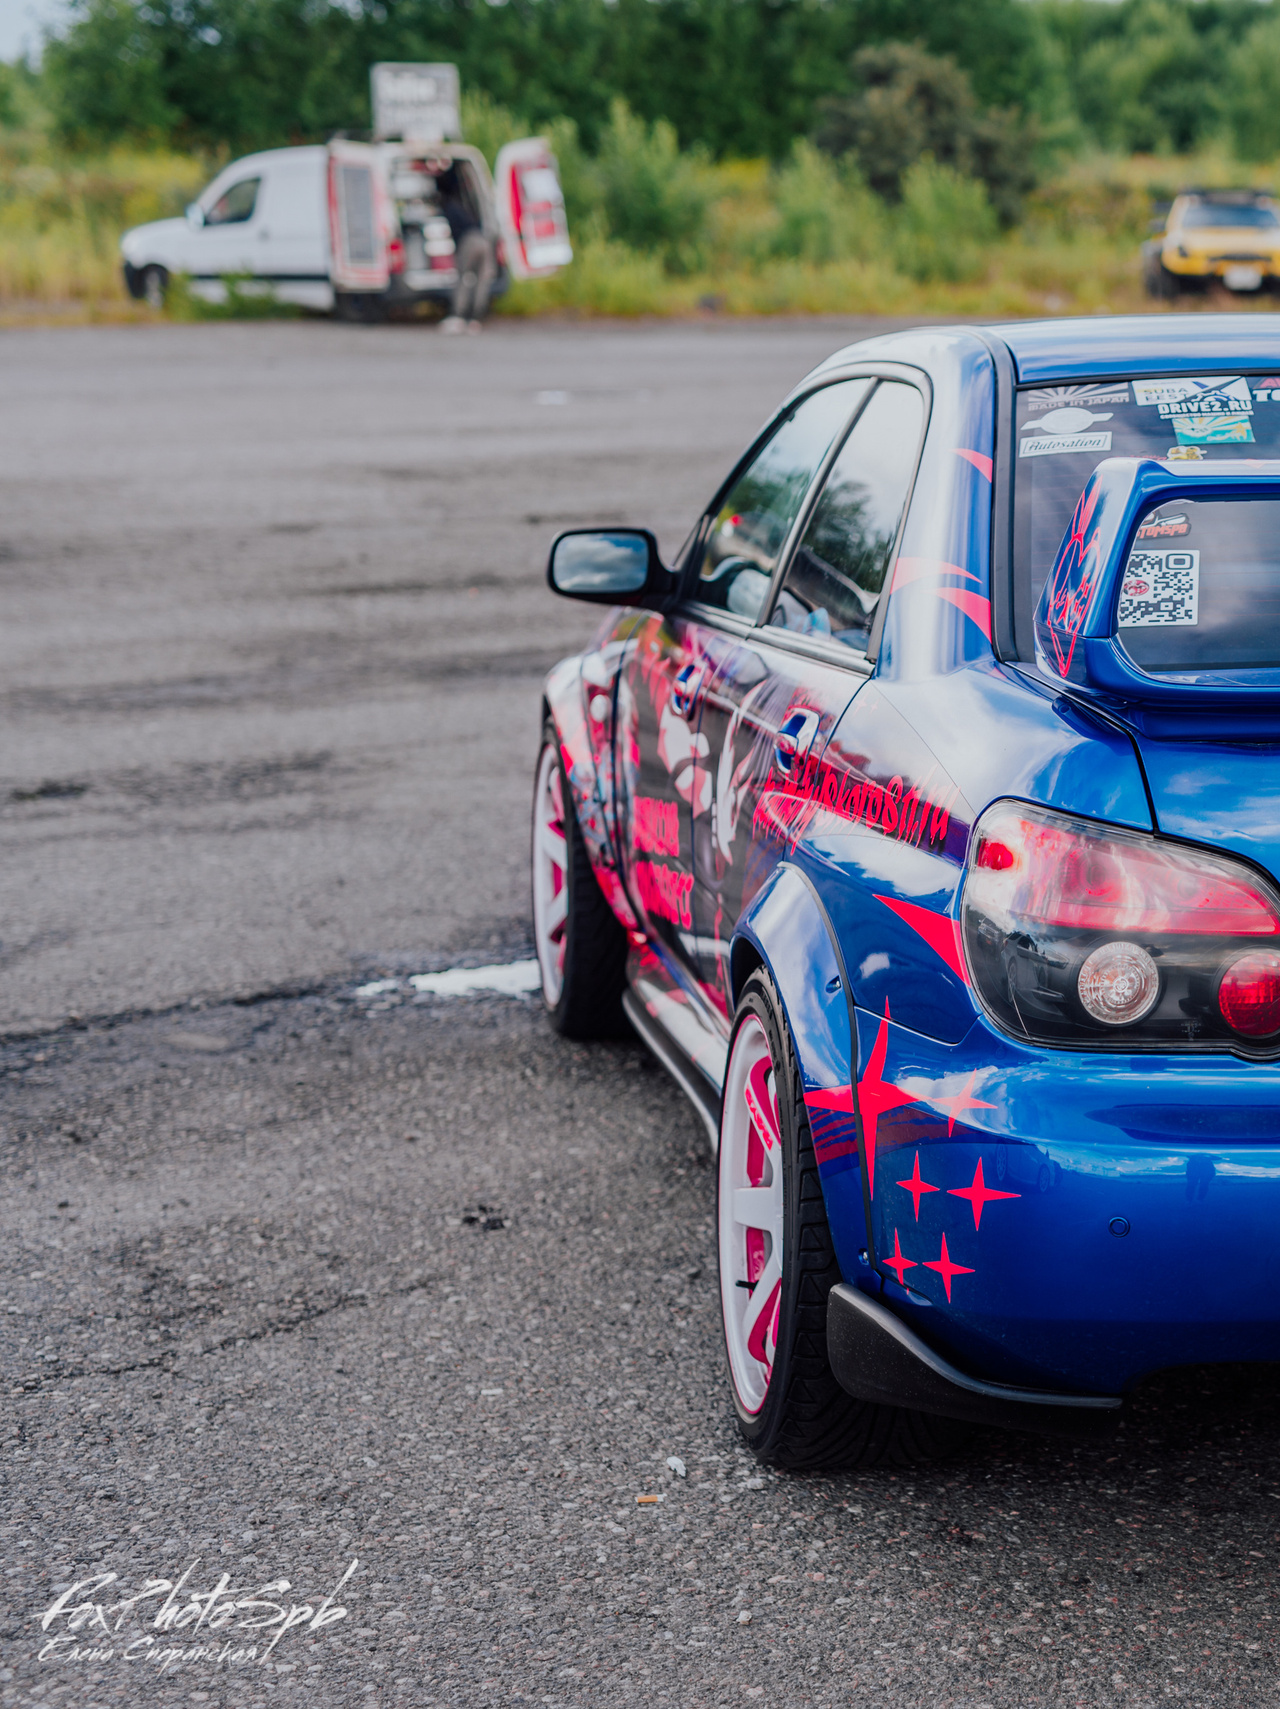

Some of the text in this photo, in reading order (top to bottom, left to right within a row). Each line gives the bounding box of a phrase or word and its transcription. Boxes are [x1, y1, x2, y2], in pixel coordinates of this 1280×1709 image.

[1028, 400, 1065, 411] MADE
[1087, 396, 1129, 405] JAPAN
[1158, 400, 1253, 415] DRIVE2.RU
[1028, 438, 1101, 451] Autosation
